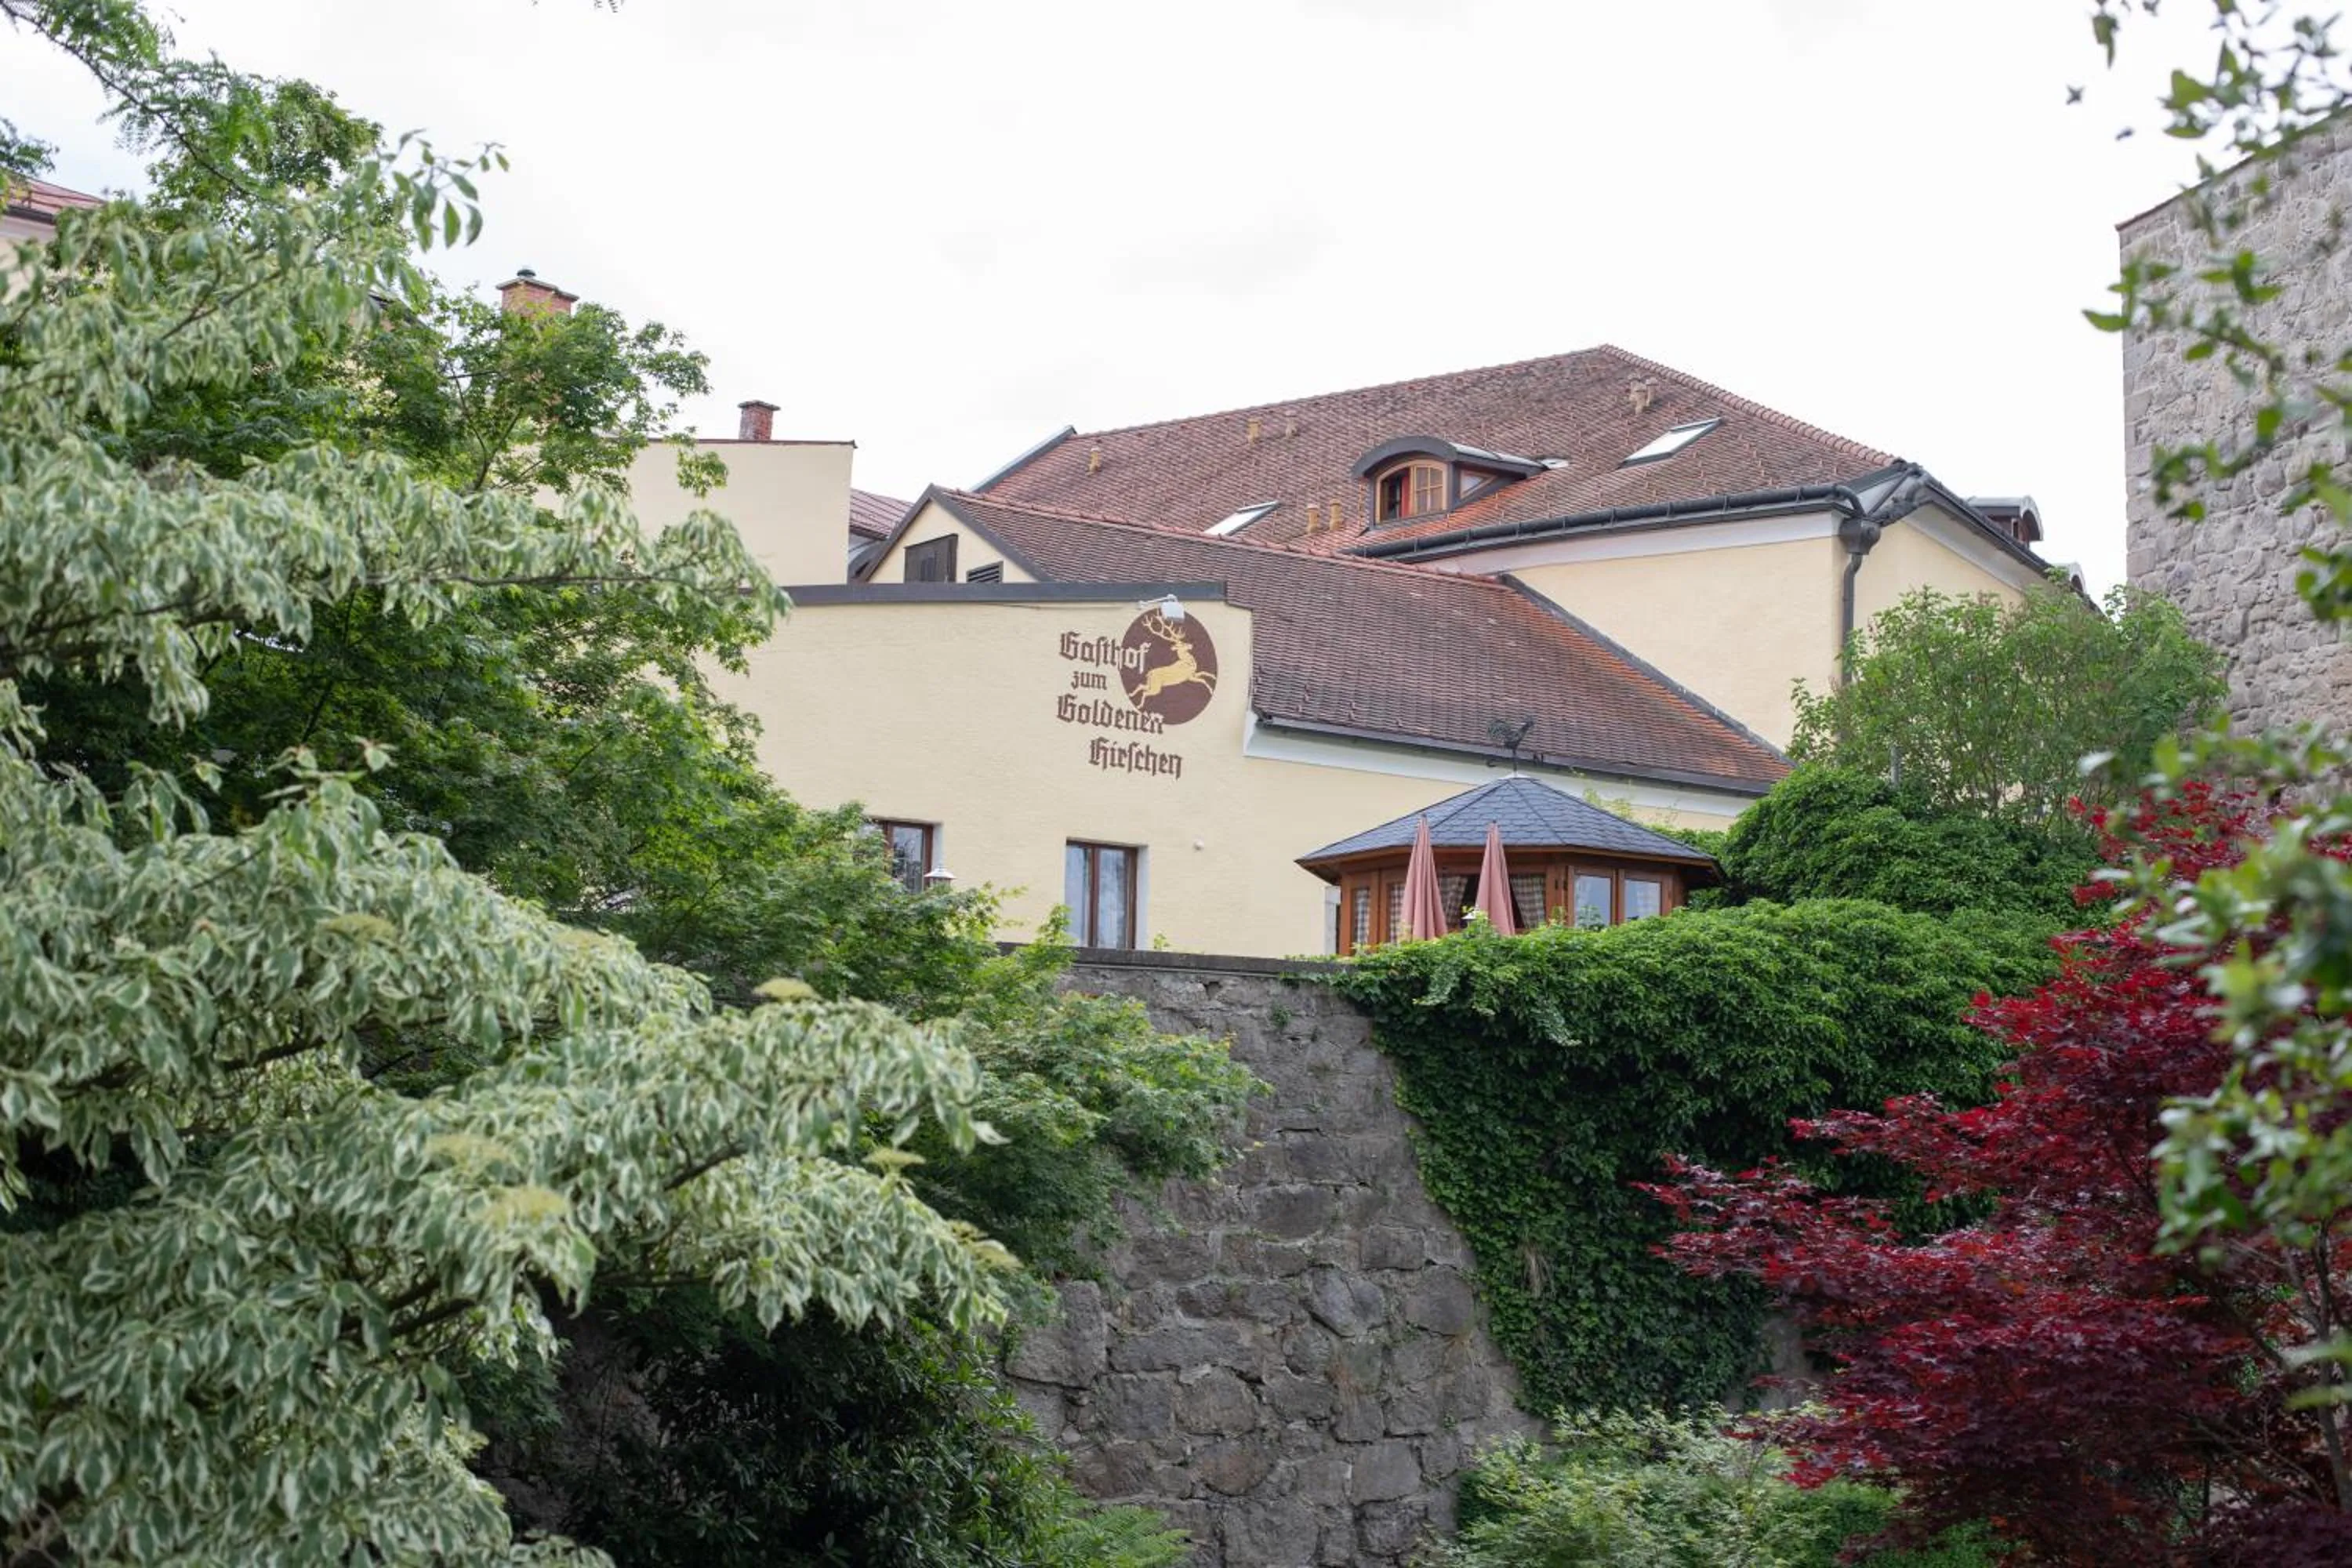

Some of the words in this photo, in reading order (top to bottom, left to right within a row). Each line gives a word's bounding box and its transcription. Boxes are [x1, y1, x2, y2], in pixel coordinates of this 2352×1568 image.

[1059, 631, 1152, 674] Gasthof
[1071, 670, 1107, 691] zum
[1057, 694, 1164, 735] Goldenen
